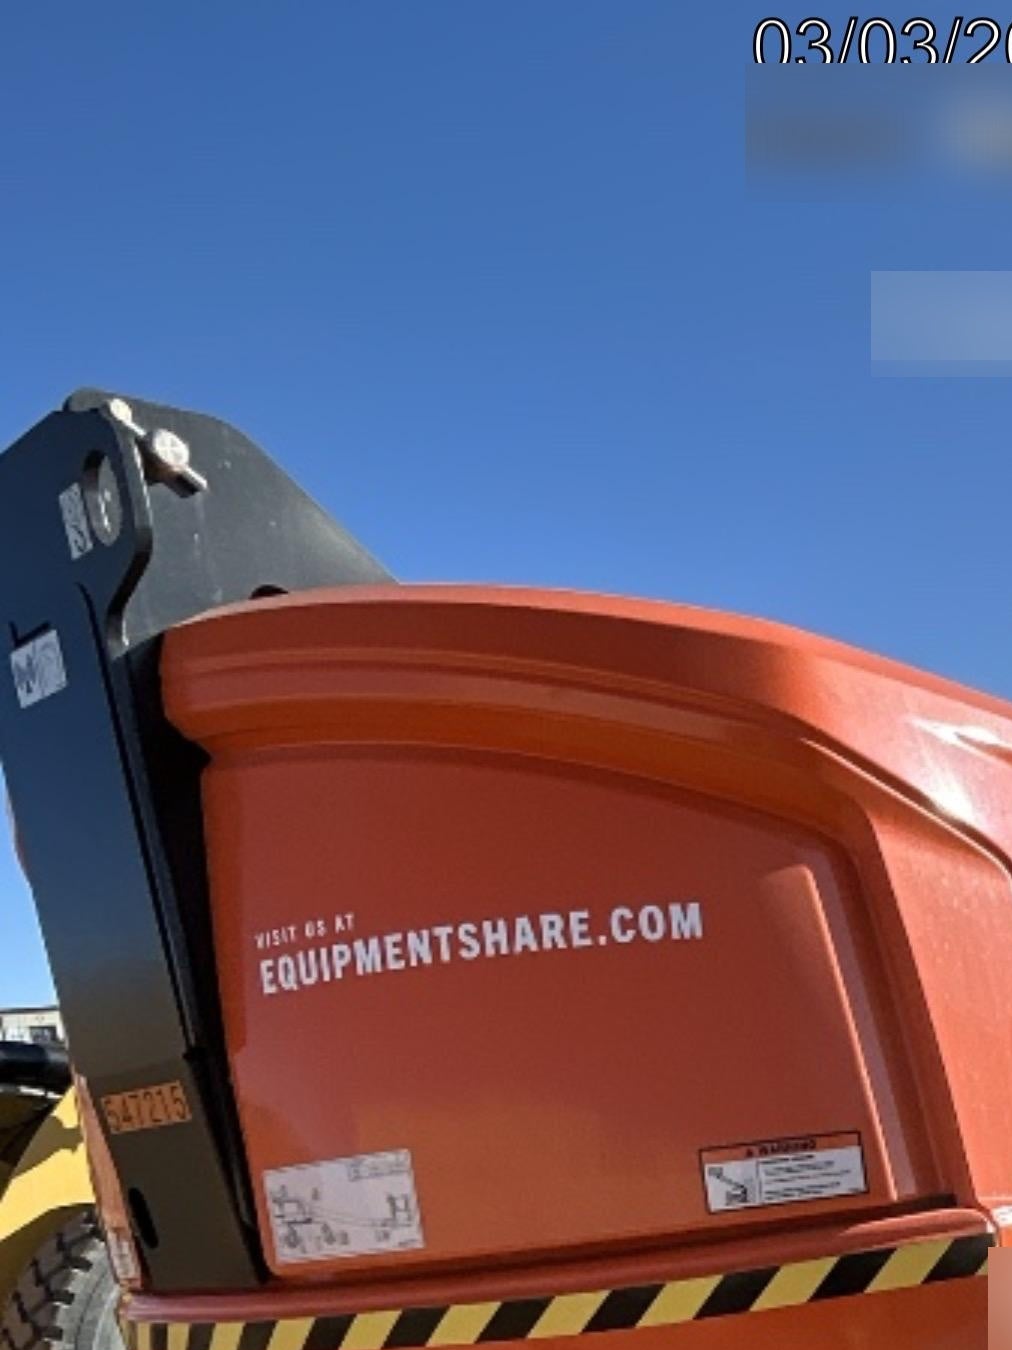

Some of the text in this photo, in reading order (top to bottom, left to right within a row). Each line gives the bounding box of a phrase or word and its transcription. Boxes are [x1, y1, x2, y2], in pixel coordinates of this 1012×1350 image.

[255, 926, 297, 949] VISIT
[335, 912, 355, 933] AT
[260, 902, 704, 995] EQUIPMENTSHARE.COM
[103, 1085, 188, 1131] 547215
